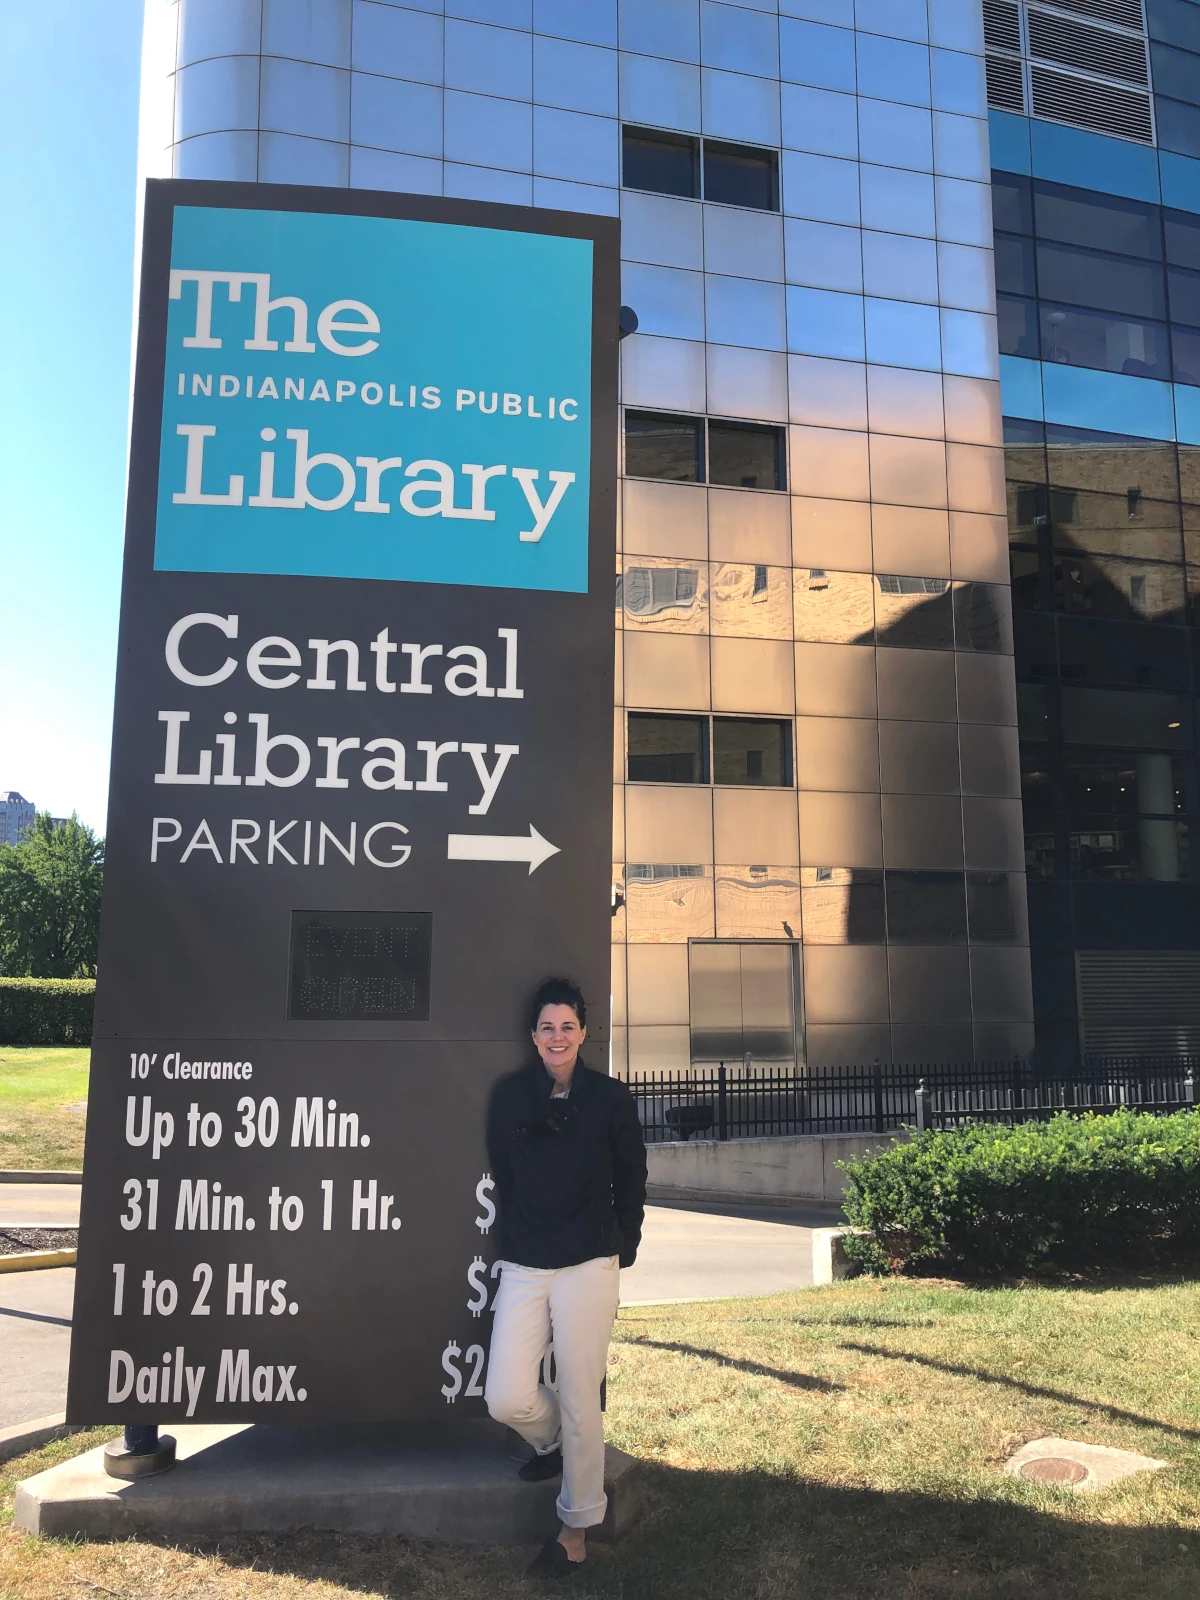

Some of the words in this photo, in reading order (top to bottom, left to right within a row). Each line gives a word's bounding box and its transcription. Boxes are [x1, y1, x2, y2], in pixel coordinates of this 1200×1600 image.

[168, 268, 381, 357] The
[177, 373, 442, 410] INDIANAPOLIS
[455, 388, 579, 421] PUBLIC
[172, 424, 576, 543] Library
[165, 612, 524, 699] Central
[154, 710, 520, 815] Library
[150, 817, 412, 868] PARKING
[162, 1052, 253, 1080] Clearance
[125, 1095, 175, 1160] Up
[186, 1102, 223, 1148] to
[234, 1096, 280, 1148] 30
[290, 1096, 371, 1148] Min.
[120, 1178, 159, 1231] 31
[174, 1179, 256, 1231] Min.
[268, 1186, 304, 1231] to
[321, 1179, 334, 1231] 1
[351, 1179, 402, 1231] Hr.
[112, 1263, 126, 1316] 1
[142, 1270, 178, 1316] to
[190, 1262, 213, 1316] 2
[226, 1263, 299, 1316] Hrs.
[107, 1346, 206, 1417] Daily
[215, 1348, 308, 1403] Max.
